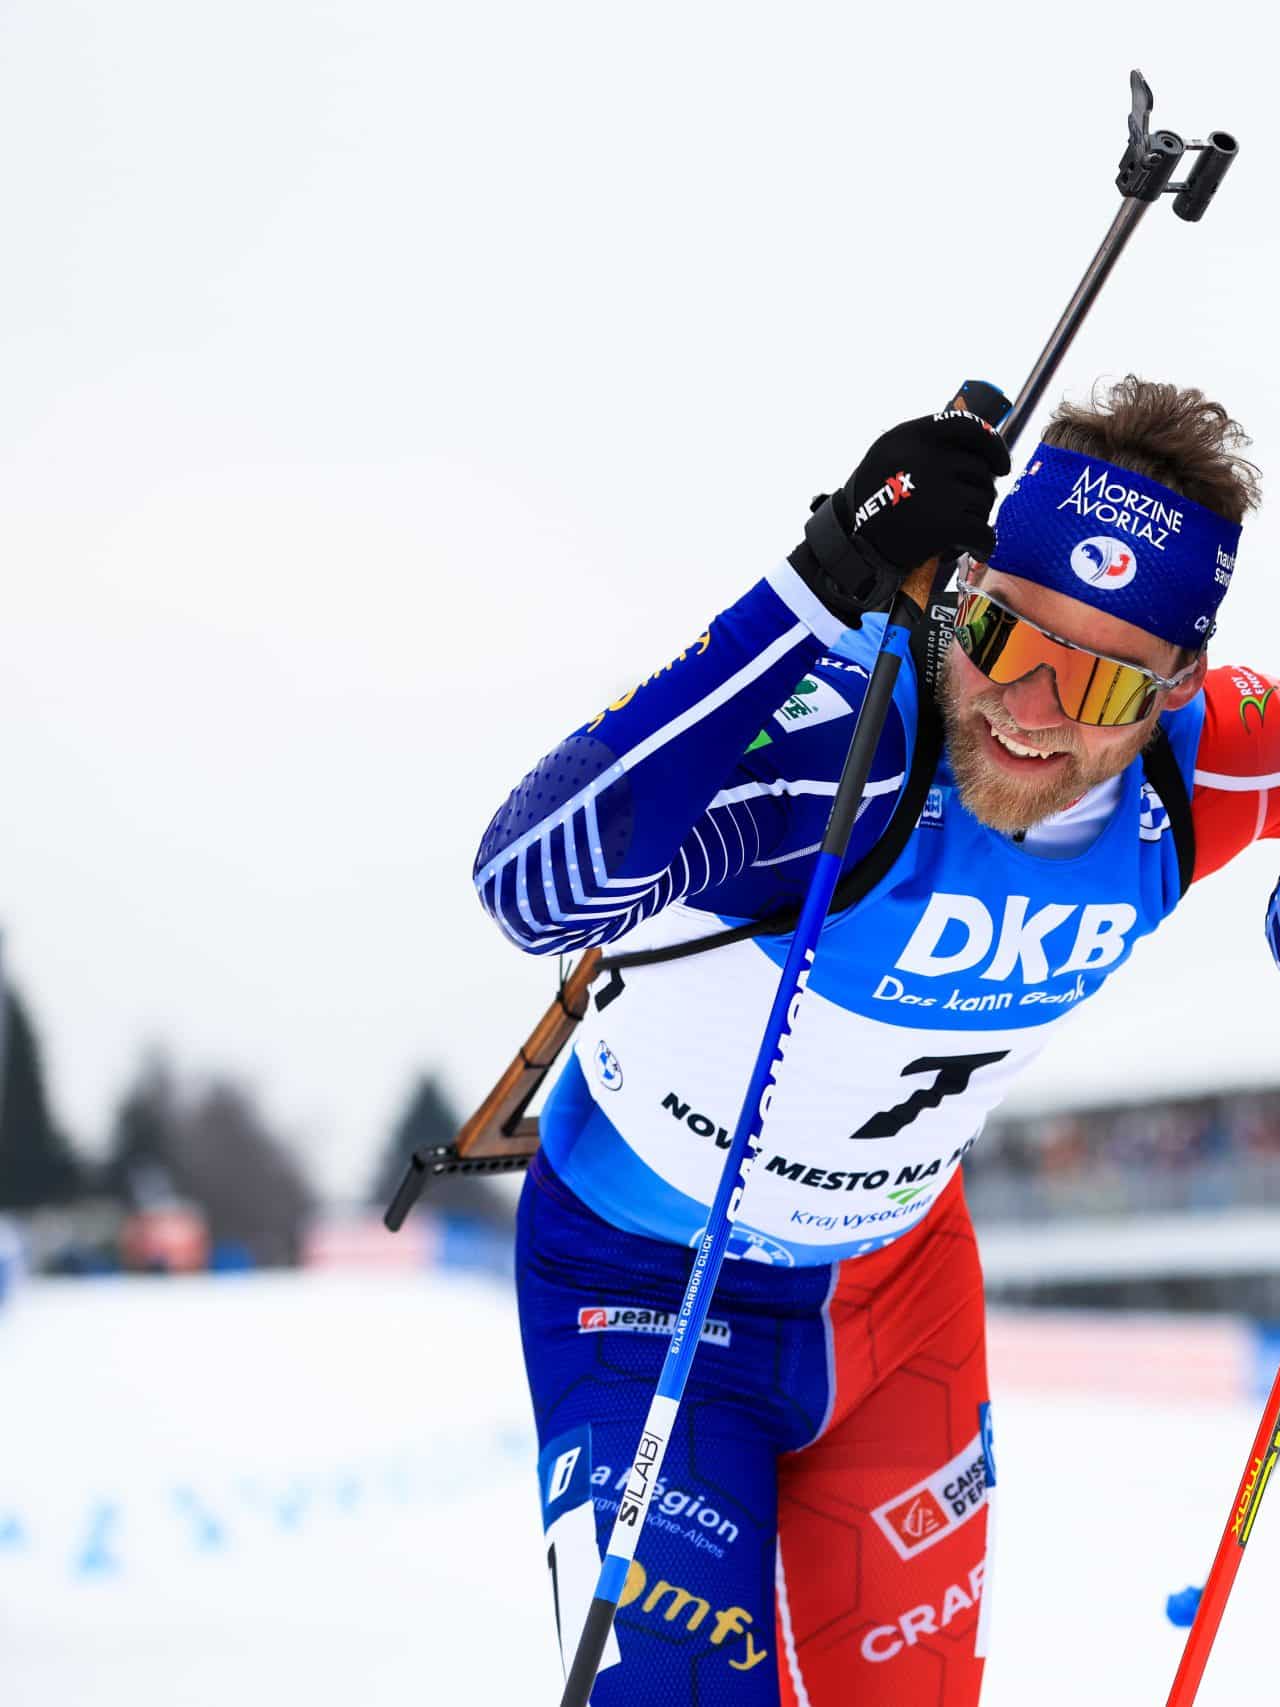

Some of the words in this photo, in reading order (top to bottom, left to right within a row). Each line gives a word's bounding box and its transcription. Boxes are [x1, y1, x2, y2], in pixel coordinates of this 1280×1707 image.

[1056, 485, 1169, 550] AVORIAZ
[1072, 465, 1184, 533] MORZINE
[893, 891, 1138, 985] DKB
[872, 974, 937, 1007] Das
[942, 989, 1013, 1012] kann
[1019, 974, 1085, 1006] Bank
[849, 1048, 1013, 1140] 7
[661, 1087, 750, 1155] NOV
[764, 1155, 890, 1192] MESTO
[894, 1158, 942, 1187] NA
[790, 1208, 838, 1230] Kraj
[682, 1269, 703, 1316] CARBON
[697, 1233, 714, 1267] CLICK
[607, 1309, 670, 1327] Jean
[860, 1559, 986, 1663] CRAF
